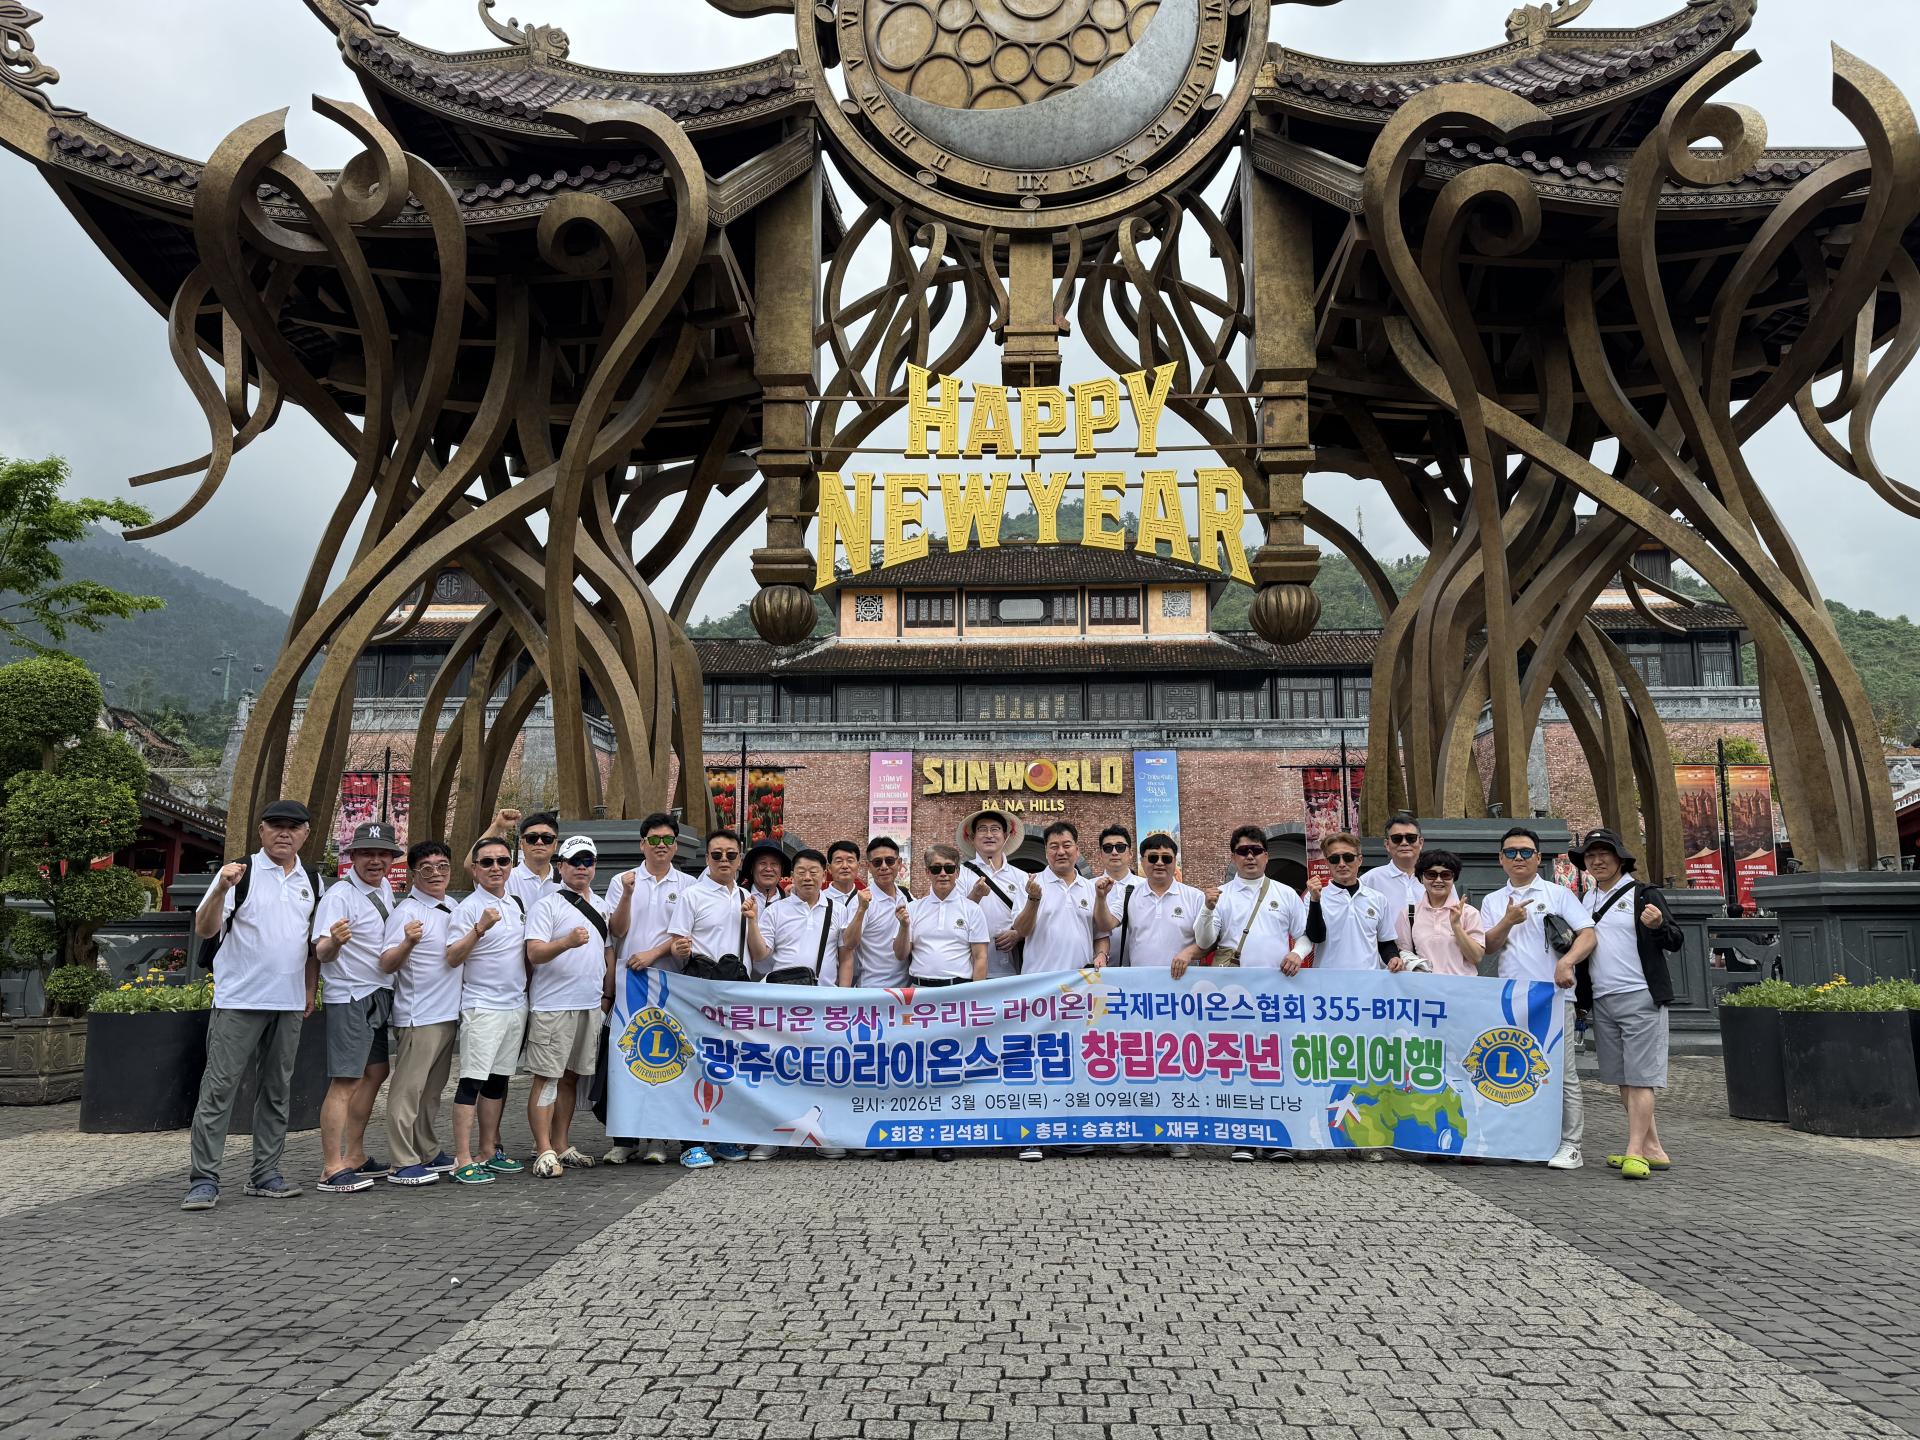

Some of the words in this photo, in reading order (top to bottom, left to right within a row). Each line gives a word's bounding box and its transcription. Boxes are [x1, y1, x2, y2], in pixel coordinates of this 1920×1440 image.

[904, 360, 1179, 460] HAPPY
[922, 757, 990, 795] SUN
[1005, 800, 1025, 812] NA
[1029, 800, 1065, 812] HILLS
[700, 1005, 816, 1032] 아름다운
[911, 1000, 997, 1029] 우리는
[1003, 992, 1094, 1023] 라이온!
[1105, 988, 1306, 1024] 국제라이온스협회
[649, 1030, 671, 1058] L
[1482, 1030, 1530, 1047] LIONS
[633, 1062, 679, 1079] INTERNATIONAL
[701, 1031, 1071, 1086] 광주CEO라이온스클럽
[1081, 1030, 1281, 1080] 창립20주년
[1291, 1034, 1444, 1088] 해외여행
[1496, 1051, 1518, 1078] L
[890, 1095, 942, 1113] 2026년
[951, 1094, 976, 1111] 3월
[985, 1092, 1048, 1111] 05일(목)
[1065, 1092, 1091, 1109] 3월
[1095, 1091, 1161, 1109] 09일(월)
[1216, 1093, 1265, 1111] 베트남
[1270, 1095, 1303, 1113] 다낭
[1480, 1083, 1531, 1101] INTERNATIONAL
[939, 1124, 988, 1142] 김석희
